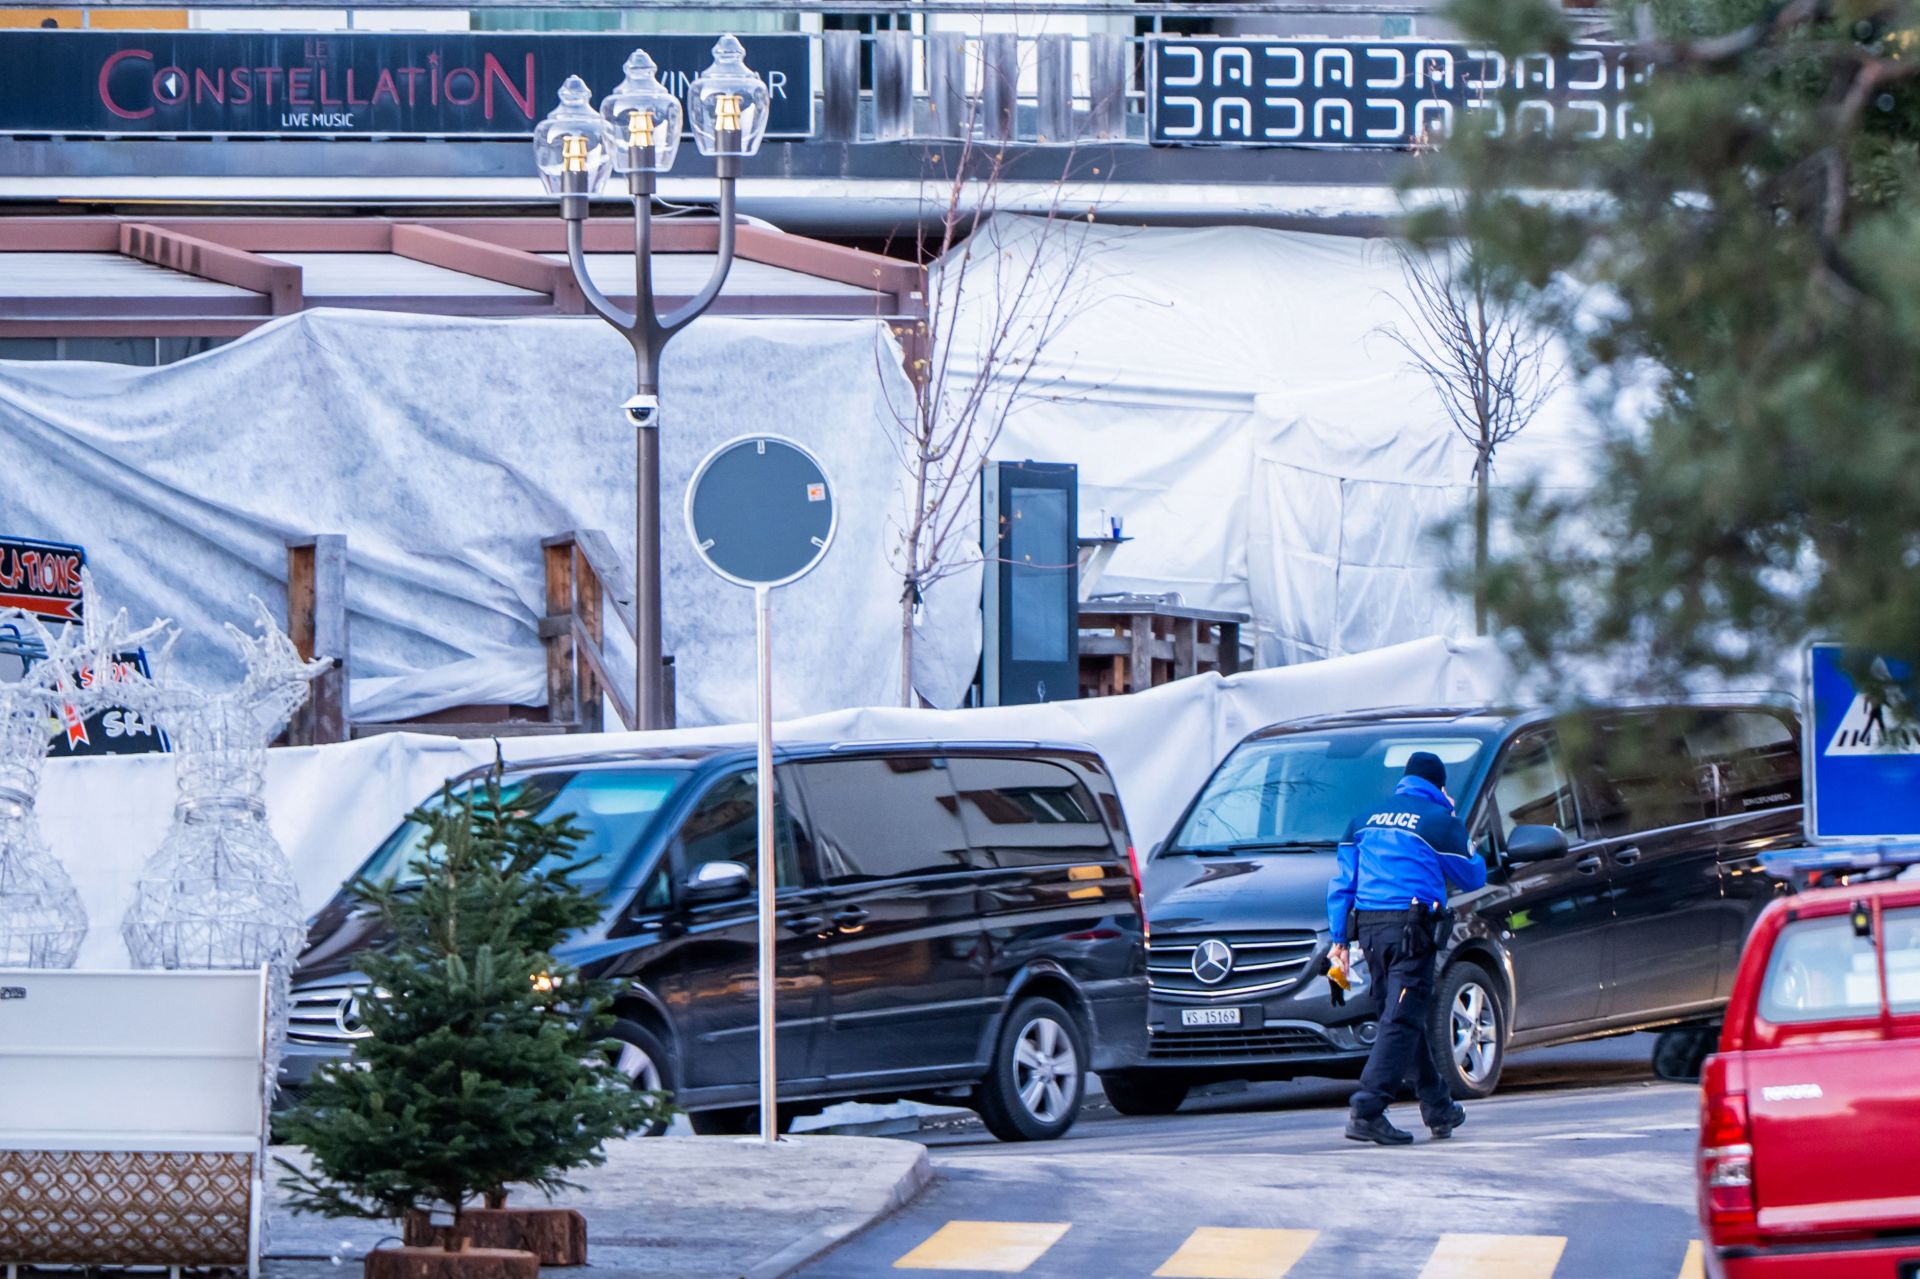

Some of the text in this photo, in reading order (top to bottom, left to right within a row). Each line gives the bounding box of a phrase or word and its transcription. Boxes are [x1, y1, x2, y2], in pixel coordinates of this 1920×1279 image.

[304, 39, 328, 58] LE
[281, 113, 353, 126] LIVE MUSIC
[1366, 812, 1421, 830] POLICE
